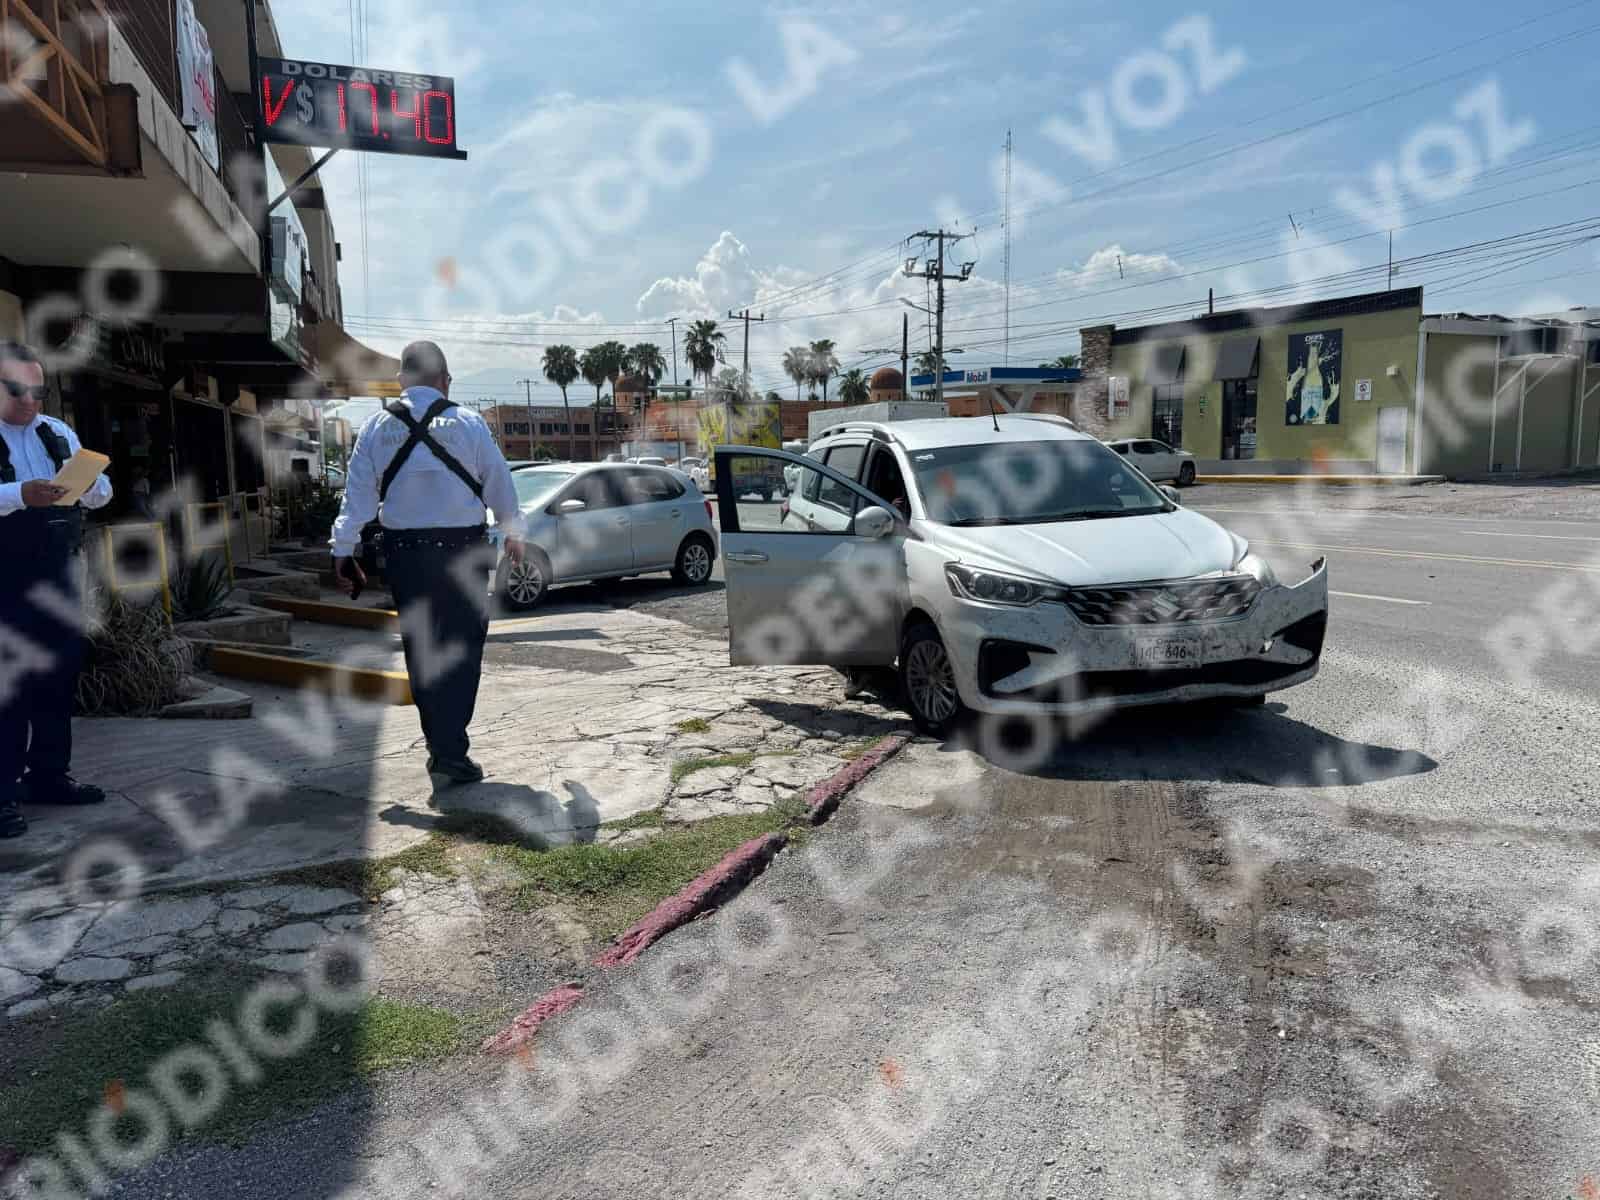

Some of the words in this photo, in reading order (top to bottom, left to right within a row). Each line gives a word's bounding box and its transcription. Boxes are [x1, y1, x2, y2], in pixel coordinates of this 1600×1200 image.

[281, 60, 432, 89] DOLARES
[337, 80, 453, 145] 17.40
[966, 370, 988, 384] Mobil
